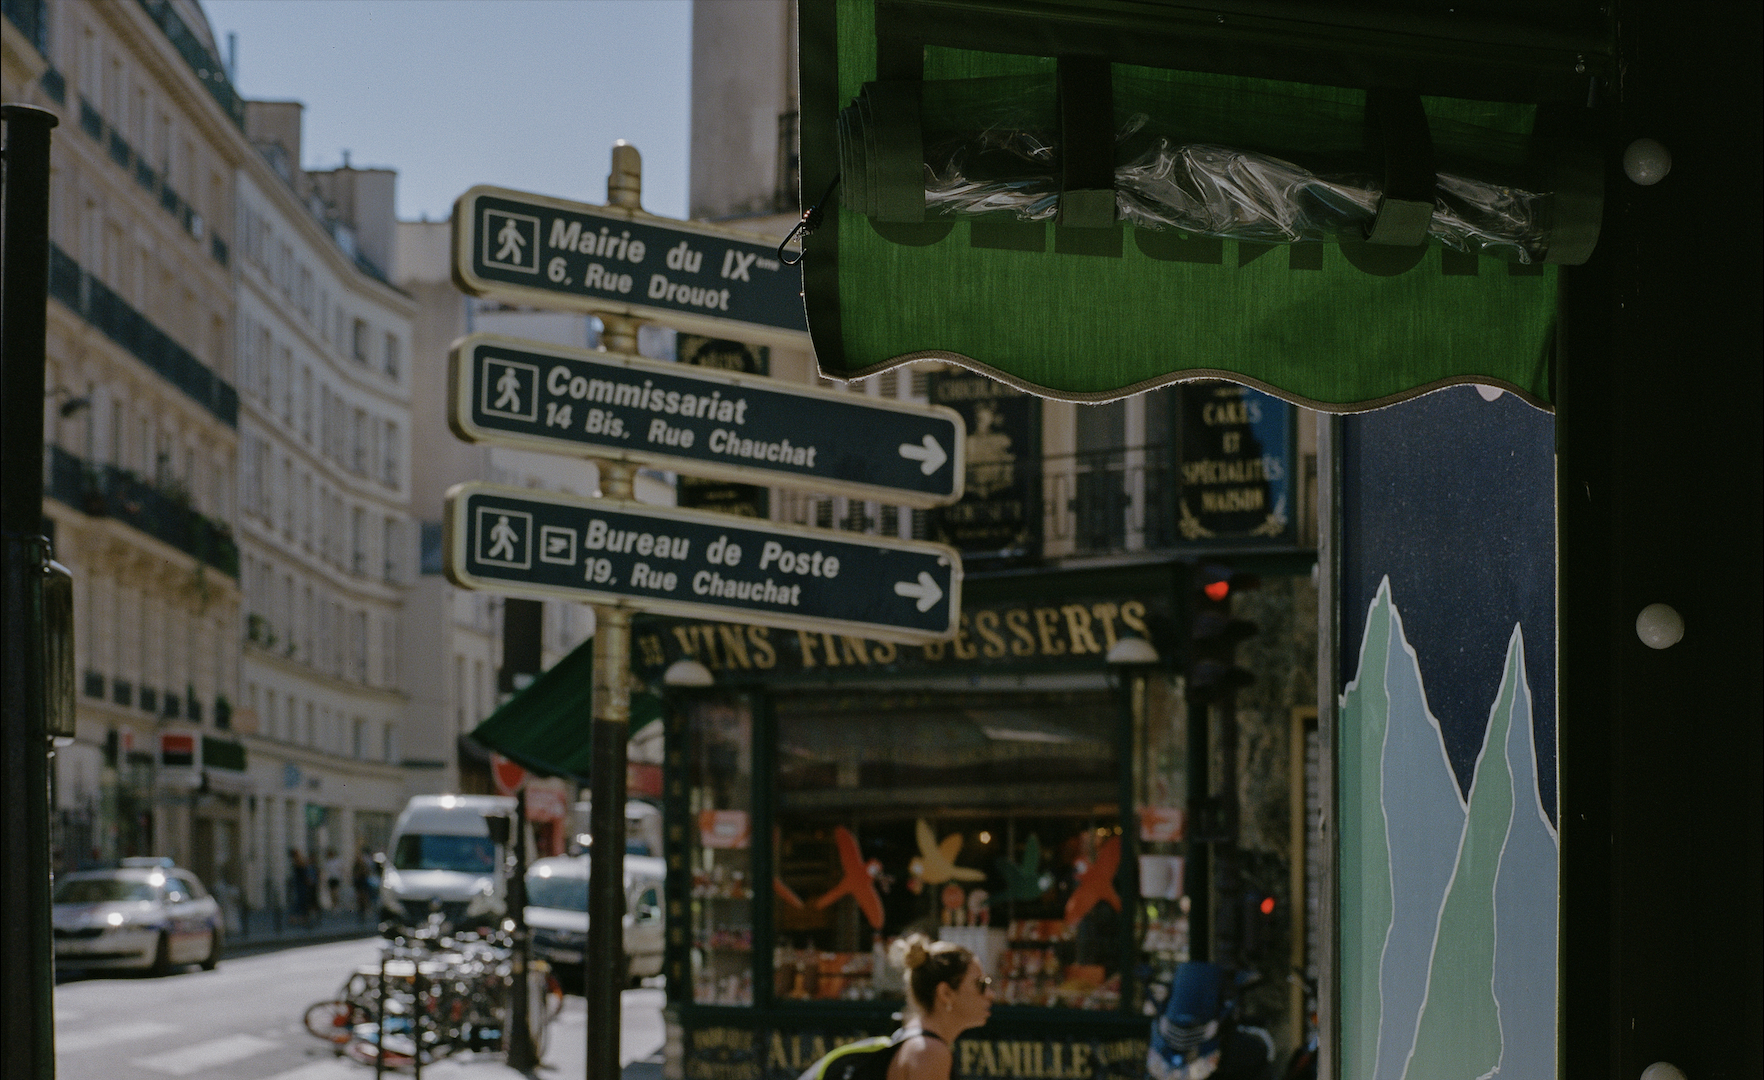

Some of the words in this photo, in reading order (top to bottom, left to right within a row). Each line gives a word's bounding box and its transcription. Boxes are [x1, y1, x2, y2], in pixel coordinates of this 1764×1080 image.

[549, 219, 646, 262] Mairie
[666, 241, 703, 272] du
[585, 263, 633, 293] Rue
[648, 275, 730, 310] Drouot
[546, 366, 747, 428] Commissariat
[1202, 399, 1263, 426] CAKES
[546, 402, 571, 429] 14
[648, 419, 695, 448] Rue
[709, 428, 817, 468] Chauchat
[585, 519, 690, 560] Bureau
[706, 535, 742, 566] de
[759, 541, 840, 579] Poste
[630, 562, 678, 592] Rue
[692, 570, 801, 606] Chauchat
[671, 624, 777, 670] VINS
[797, 628, 897, 668] FINS
[959, 1038, 1093, 1079] FAMILLE
